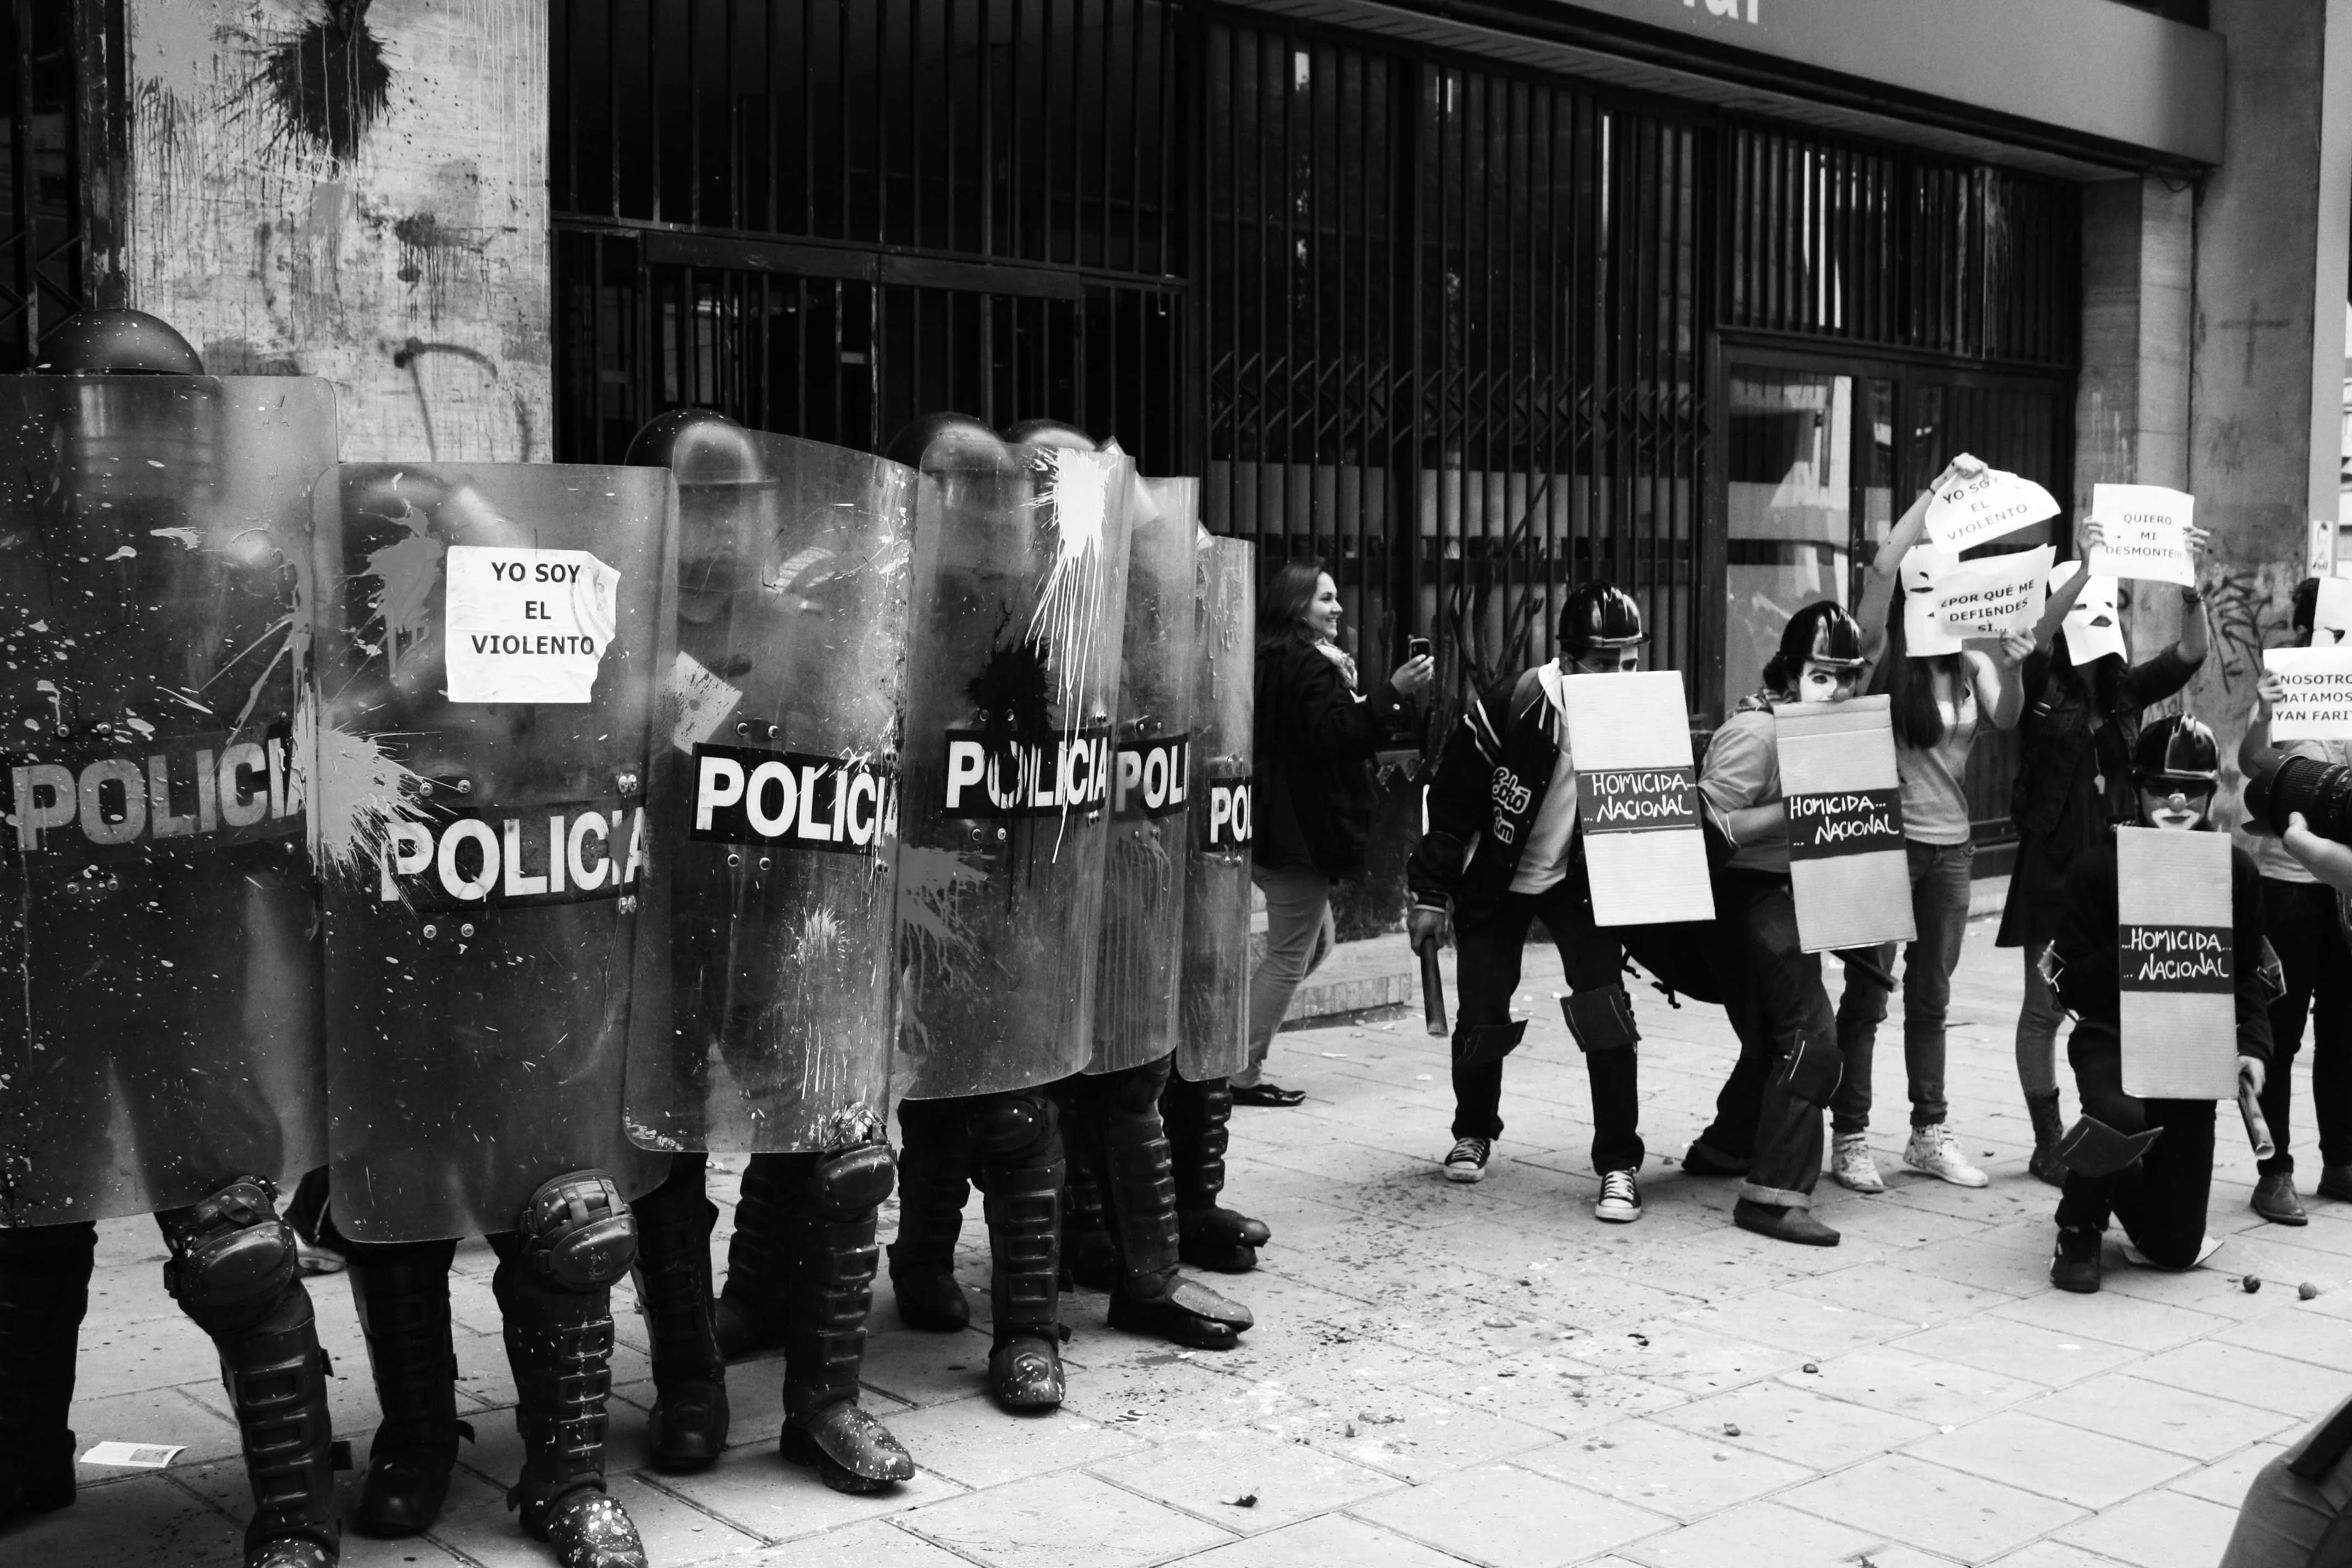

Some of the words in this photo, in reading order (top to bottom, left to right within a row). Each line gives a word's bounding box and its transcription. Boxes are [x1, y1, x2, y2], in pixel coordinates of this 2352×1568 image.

[1943, 489, 1964, 504] YO
[1969, 476, 1999, 493] SOY
[1971, 501, 1990, 513] EL
[1946, 504, 2027, 540] VIOLENTO
[2124, 514, 2172, 525] QUIERO
[2141, 531, 2157, 540] MI
[491, 562, 526, 582] YO
[536, 563, 581, 583] SOY
[2019, 579, 2035, 594] ME
[525, 601, 552, 620] EL
[471, 635, 595, 655] VIOLENTO
[2276, 711, 2306, 721] YAN
[1597, 794, 1693, 823] NACIONAL
[1815, 814, 1899, 845] NACIONAL
[2138, 952, 2229, 980] NACIONAL
